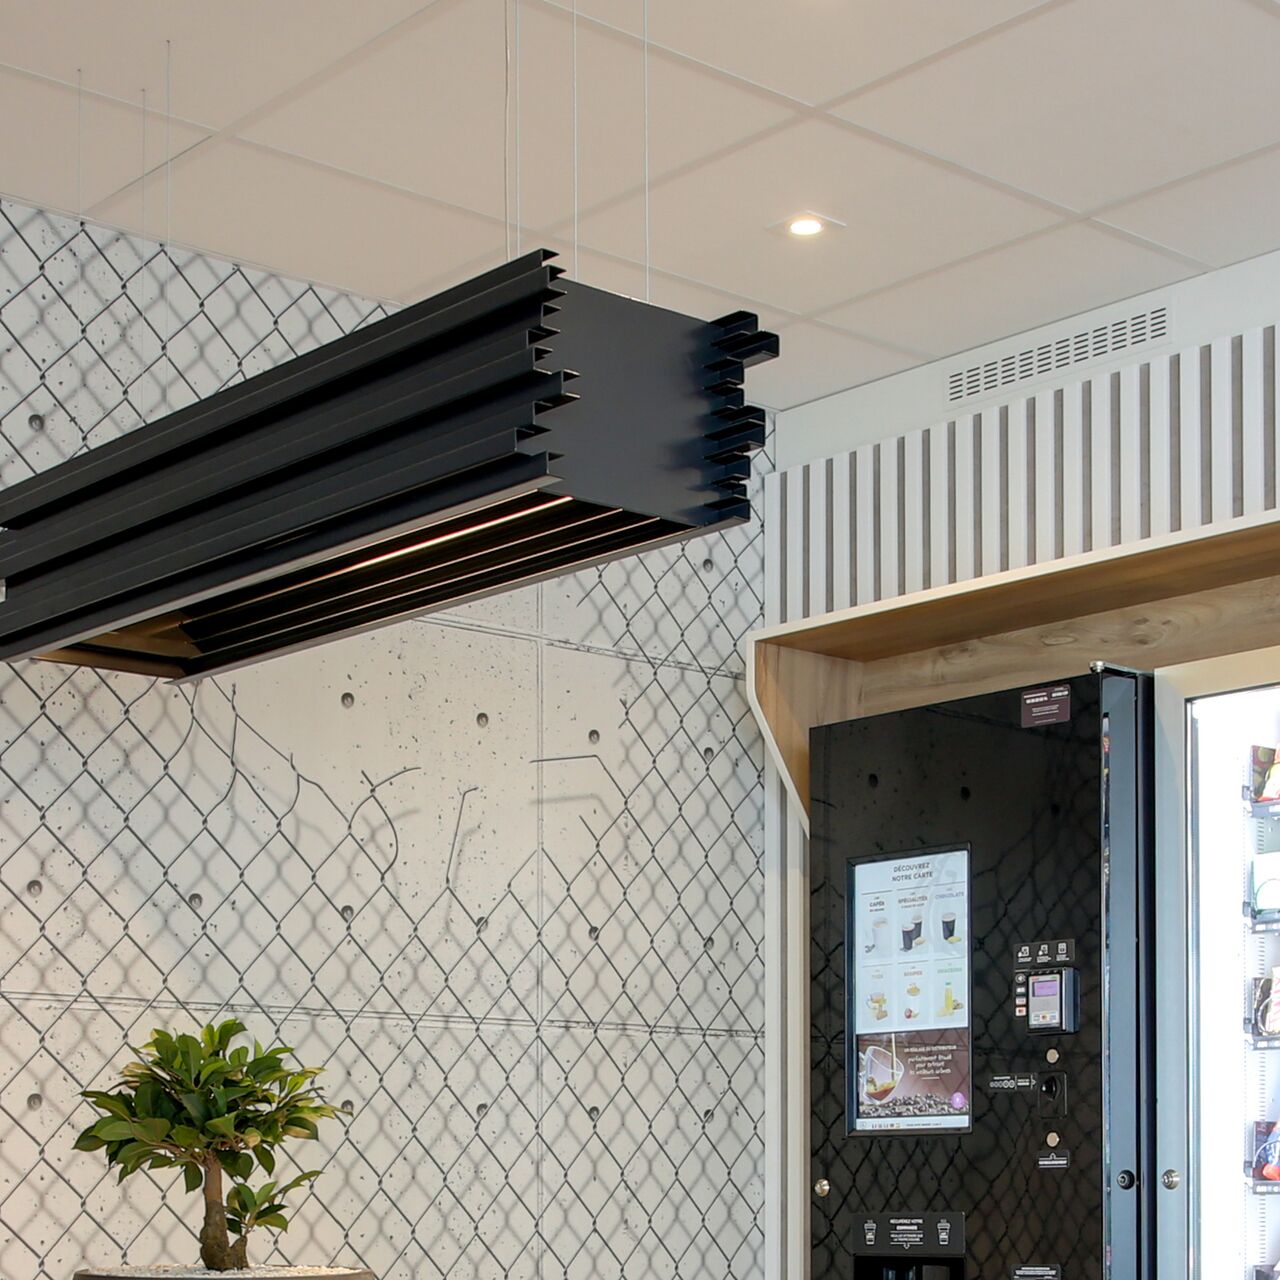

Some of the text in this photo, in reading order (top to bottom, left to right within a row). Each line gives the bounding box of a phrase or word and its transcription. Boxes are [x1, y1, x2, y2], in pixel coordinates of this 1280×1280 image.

[893, 862, 930, 873] DÉCOUVREZ
[891, 871, 934, 882] NOTRE CARTE
